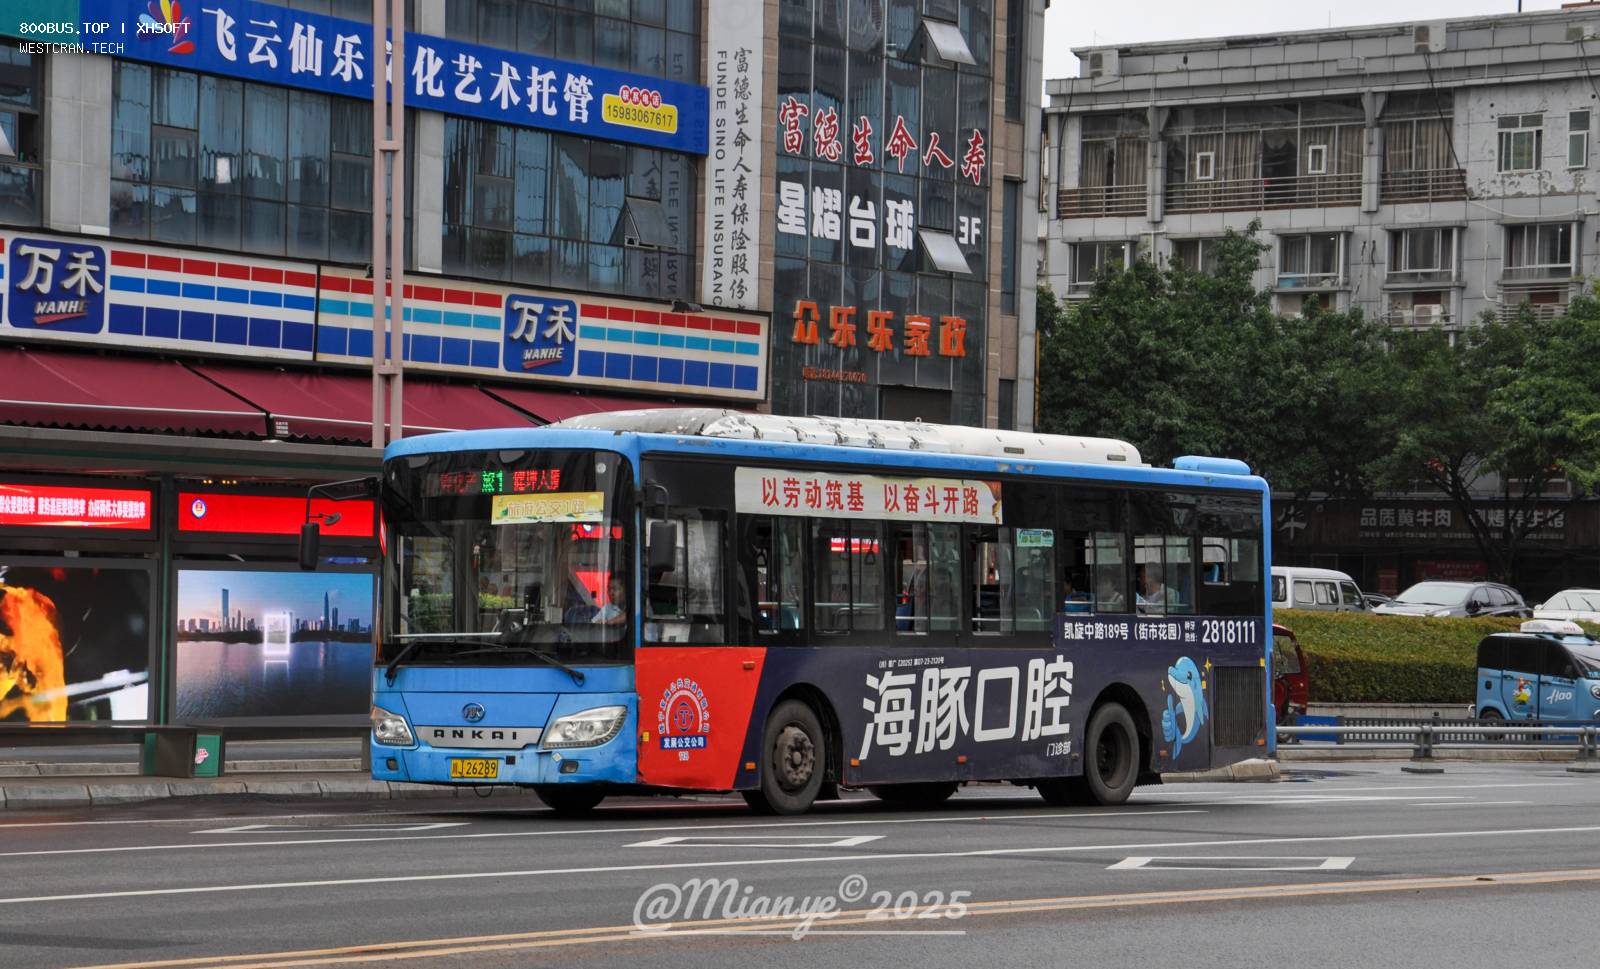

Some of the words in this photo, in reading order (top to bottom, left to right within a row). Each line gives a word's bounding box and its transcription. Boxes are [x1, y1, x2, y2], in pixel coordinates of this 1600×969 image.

[202, 8, 594, 123] 飞云仙乐化艺术托管
[716, 51, 727, 110] FUNDE
[608, 104, 673, 127] 15983067617
[621, 87, 661, 108] 联系电话
[715, 119, 726, 161] SINO
[779, 96, 987, 186] 富德生命人寿
[714, 169, 725, 206] LIFE
[776, 181, 915, 250] 星熠台球
[959, 215, 982, 245] 3F
[16, 244, 104, 297] 万禾
[34, 299, 88, 315] WANHE
[509, 300, 576, 345] 万禾
[792, 300, 967, 358] 众乐乐家政
[523, 347, 565, 361] WANHE
[761, 477, 865, 513] 以劳动筑基
[883, 483, 979, 516] 以奋斗开路
[1202, 619, 1256, 644] 2818111
[858, 654, 1074, 760] 海豚口腔
[433, 729, 517, 740] ANKAI
[1046, 741, 1072, 757] 门诊部
